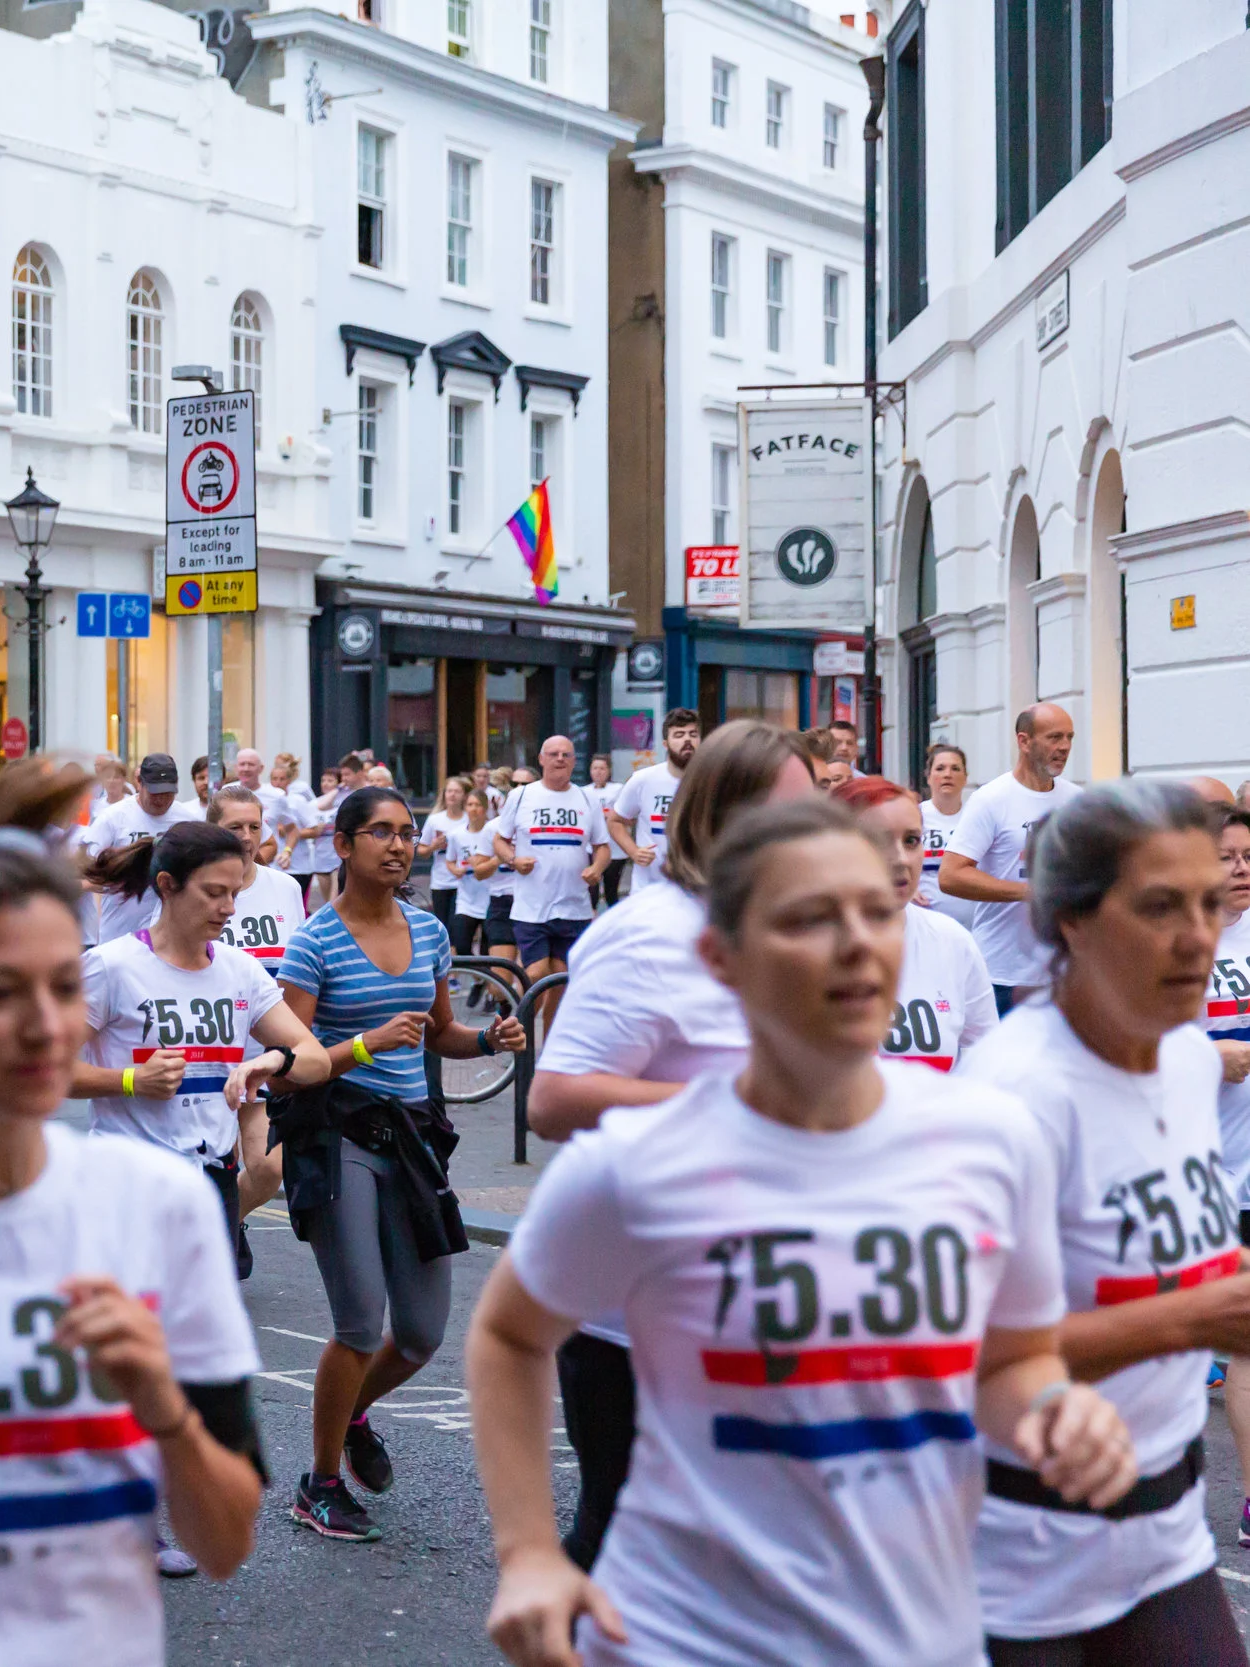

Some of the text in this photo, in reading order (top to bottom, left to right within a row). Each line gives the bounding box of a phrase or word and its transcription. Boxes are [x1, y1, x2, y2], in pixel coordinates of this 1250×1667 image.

[172, 398, 249, 417] PEDESTRIAN
[183, 414, 237, 437] ZONE
[751, 434, 860, 462] FATFACE
[182, 525, 240, 541] Except for
[190, 540, 231, 553] loading
[179, 557, 186, 568] 8
[189, 558, 205, 567] am
[214, 555, 224, 565] 11
[227, 556, 244, 565] am
[692, 559, 719, 576] TO
[206, 580, 244, 593] At any
[212, 594, 238, 606] time
[540, 808, 578, 826] 5.30
[154, 998, 235, 1046] 5.30
[1131, 1148, 1240, 1266] 5.30
[751, 1223, 968, 1342] 5.30
